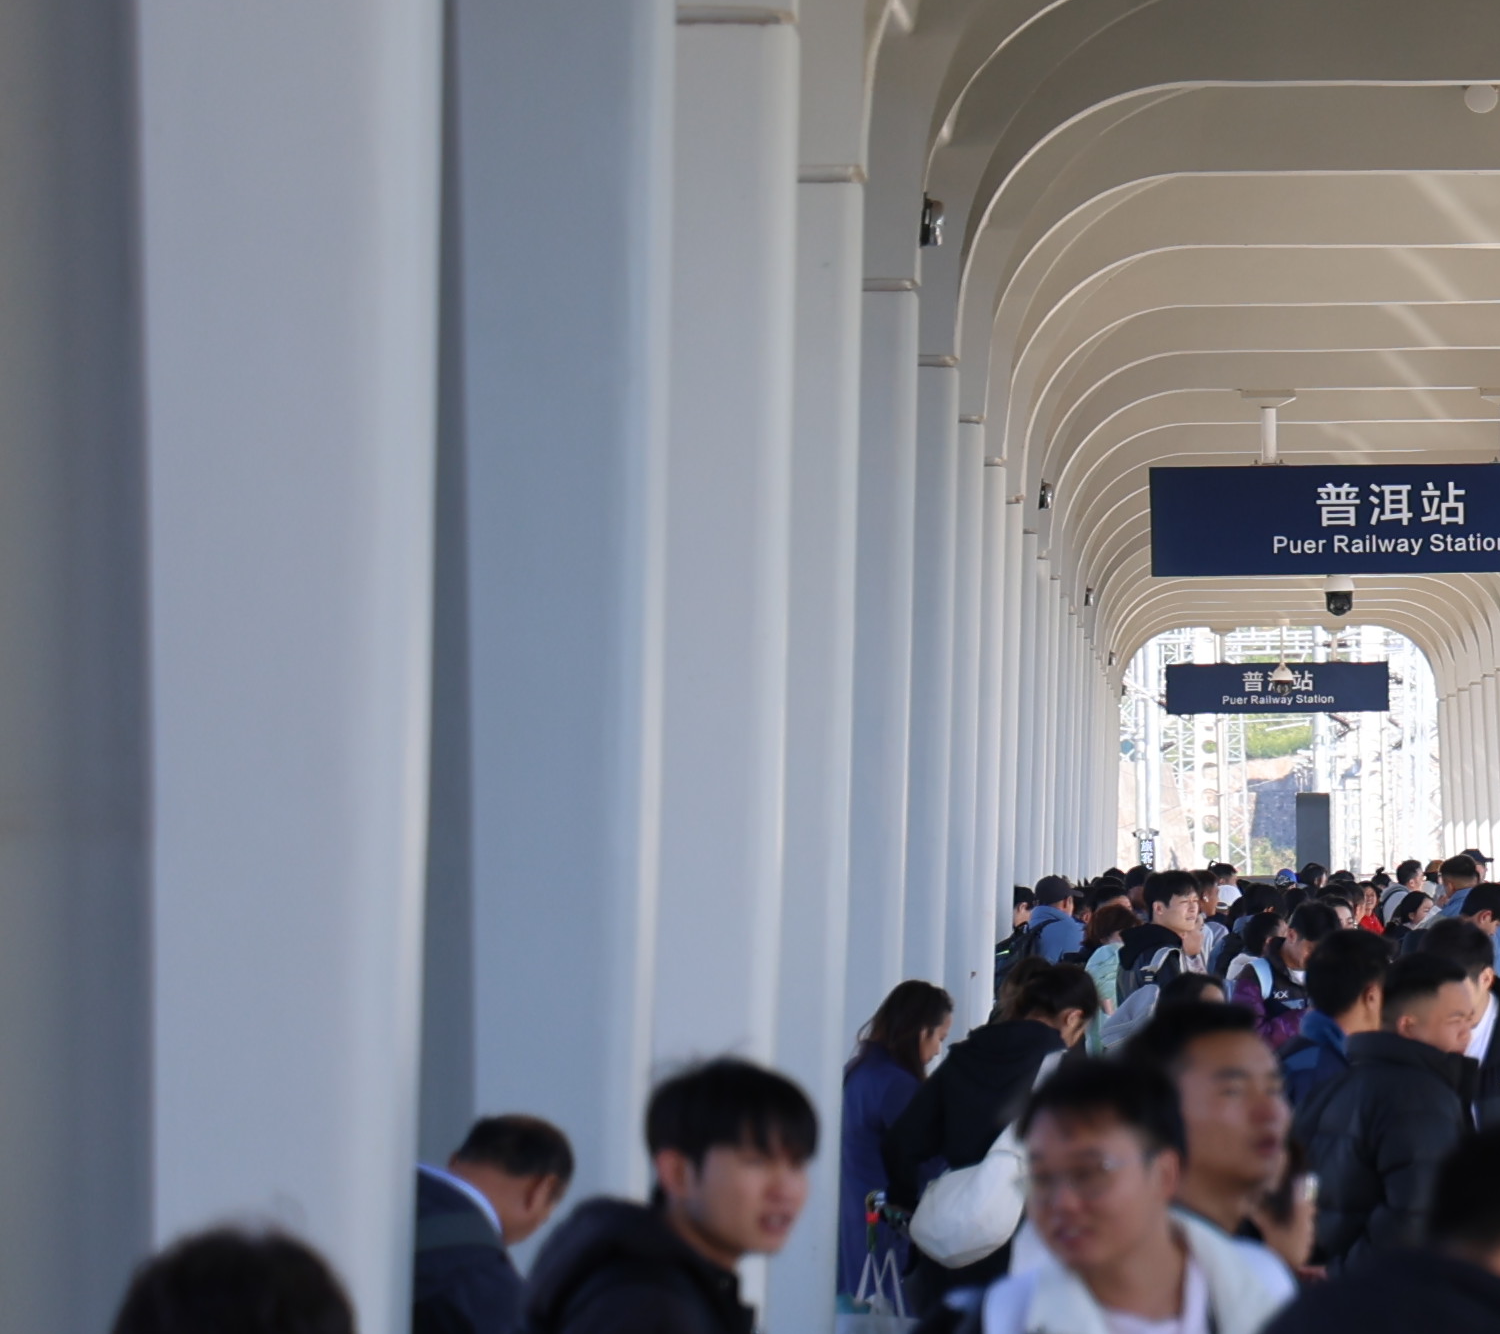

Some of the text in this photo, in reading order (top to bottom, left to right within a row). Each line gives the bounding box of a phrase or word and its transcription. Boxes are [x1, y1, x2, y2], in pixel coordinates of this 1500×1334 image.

[1316, 482, 1466, 527] 普洱站
[1273, 535, 1327, 554] Puer
[1333, 535, 1423, 556] Railway
[1222, 694, 1335, 706] Puer Railway Station
